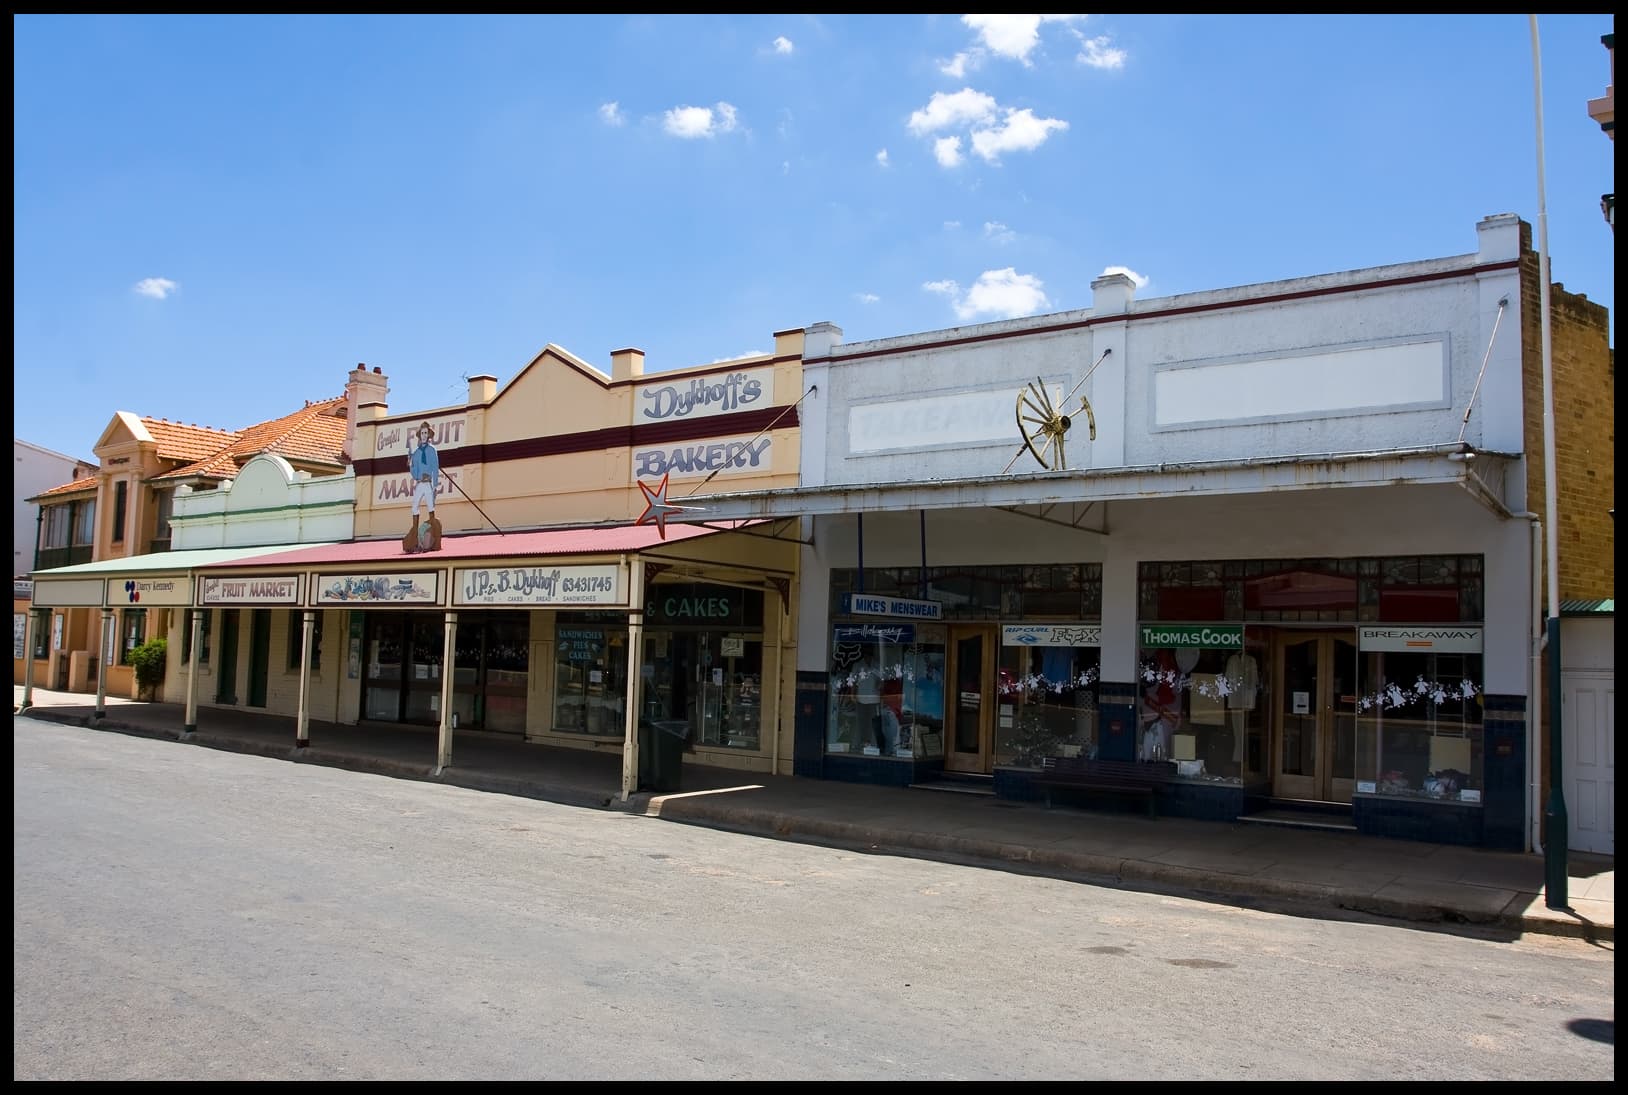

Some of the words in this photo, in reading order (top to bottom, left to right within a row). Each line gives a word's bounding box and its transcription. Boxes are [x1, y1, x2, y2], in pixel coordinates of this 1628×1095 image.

[643, 373, 762, 419] Dykhoff's
[406, 420, 465, 449] FUIT
[635, 438, 772, 477] BAKERY
[378, 472, 458, 500] MARET
[222, 582, 247, 598] FRUIT
[249, 581, 295, 598] MARKET
[513, 569, 561, 597] Dykhoff
[562, 576, 612, 593] 63431745
[646, 601, 656, 616] &
[664, 597, 730, 617] CAKES
[855, 598, 887, 613] MIKE'S
[891, 601, 938, 617] MENSWEAR
[1050, 627, 1101, 646] FOX
[1363, 630, 1478, 639] BREAKAWAY
[568, 651, 592, 661] CAKES
